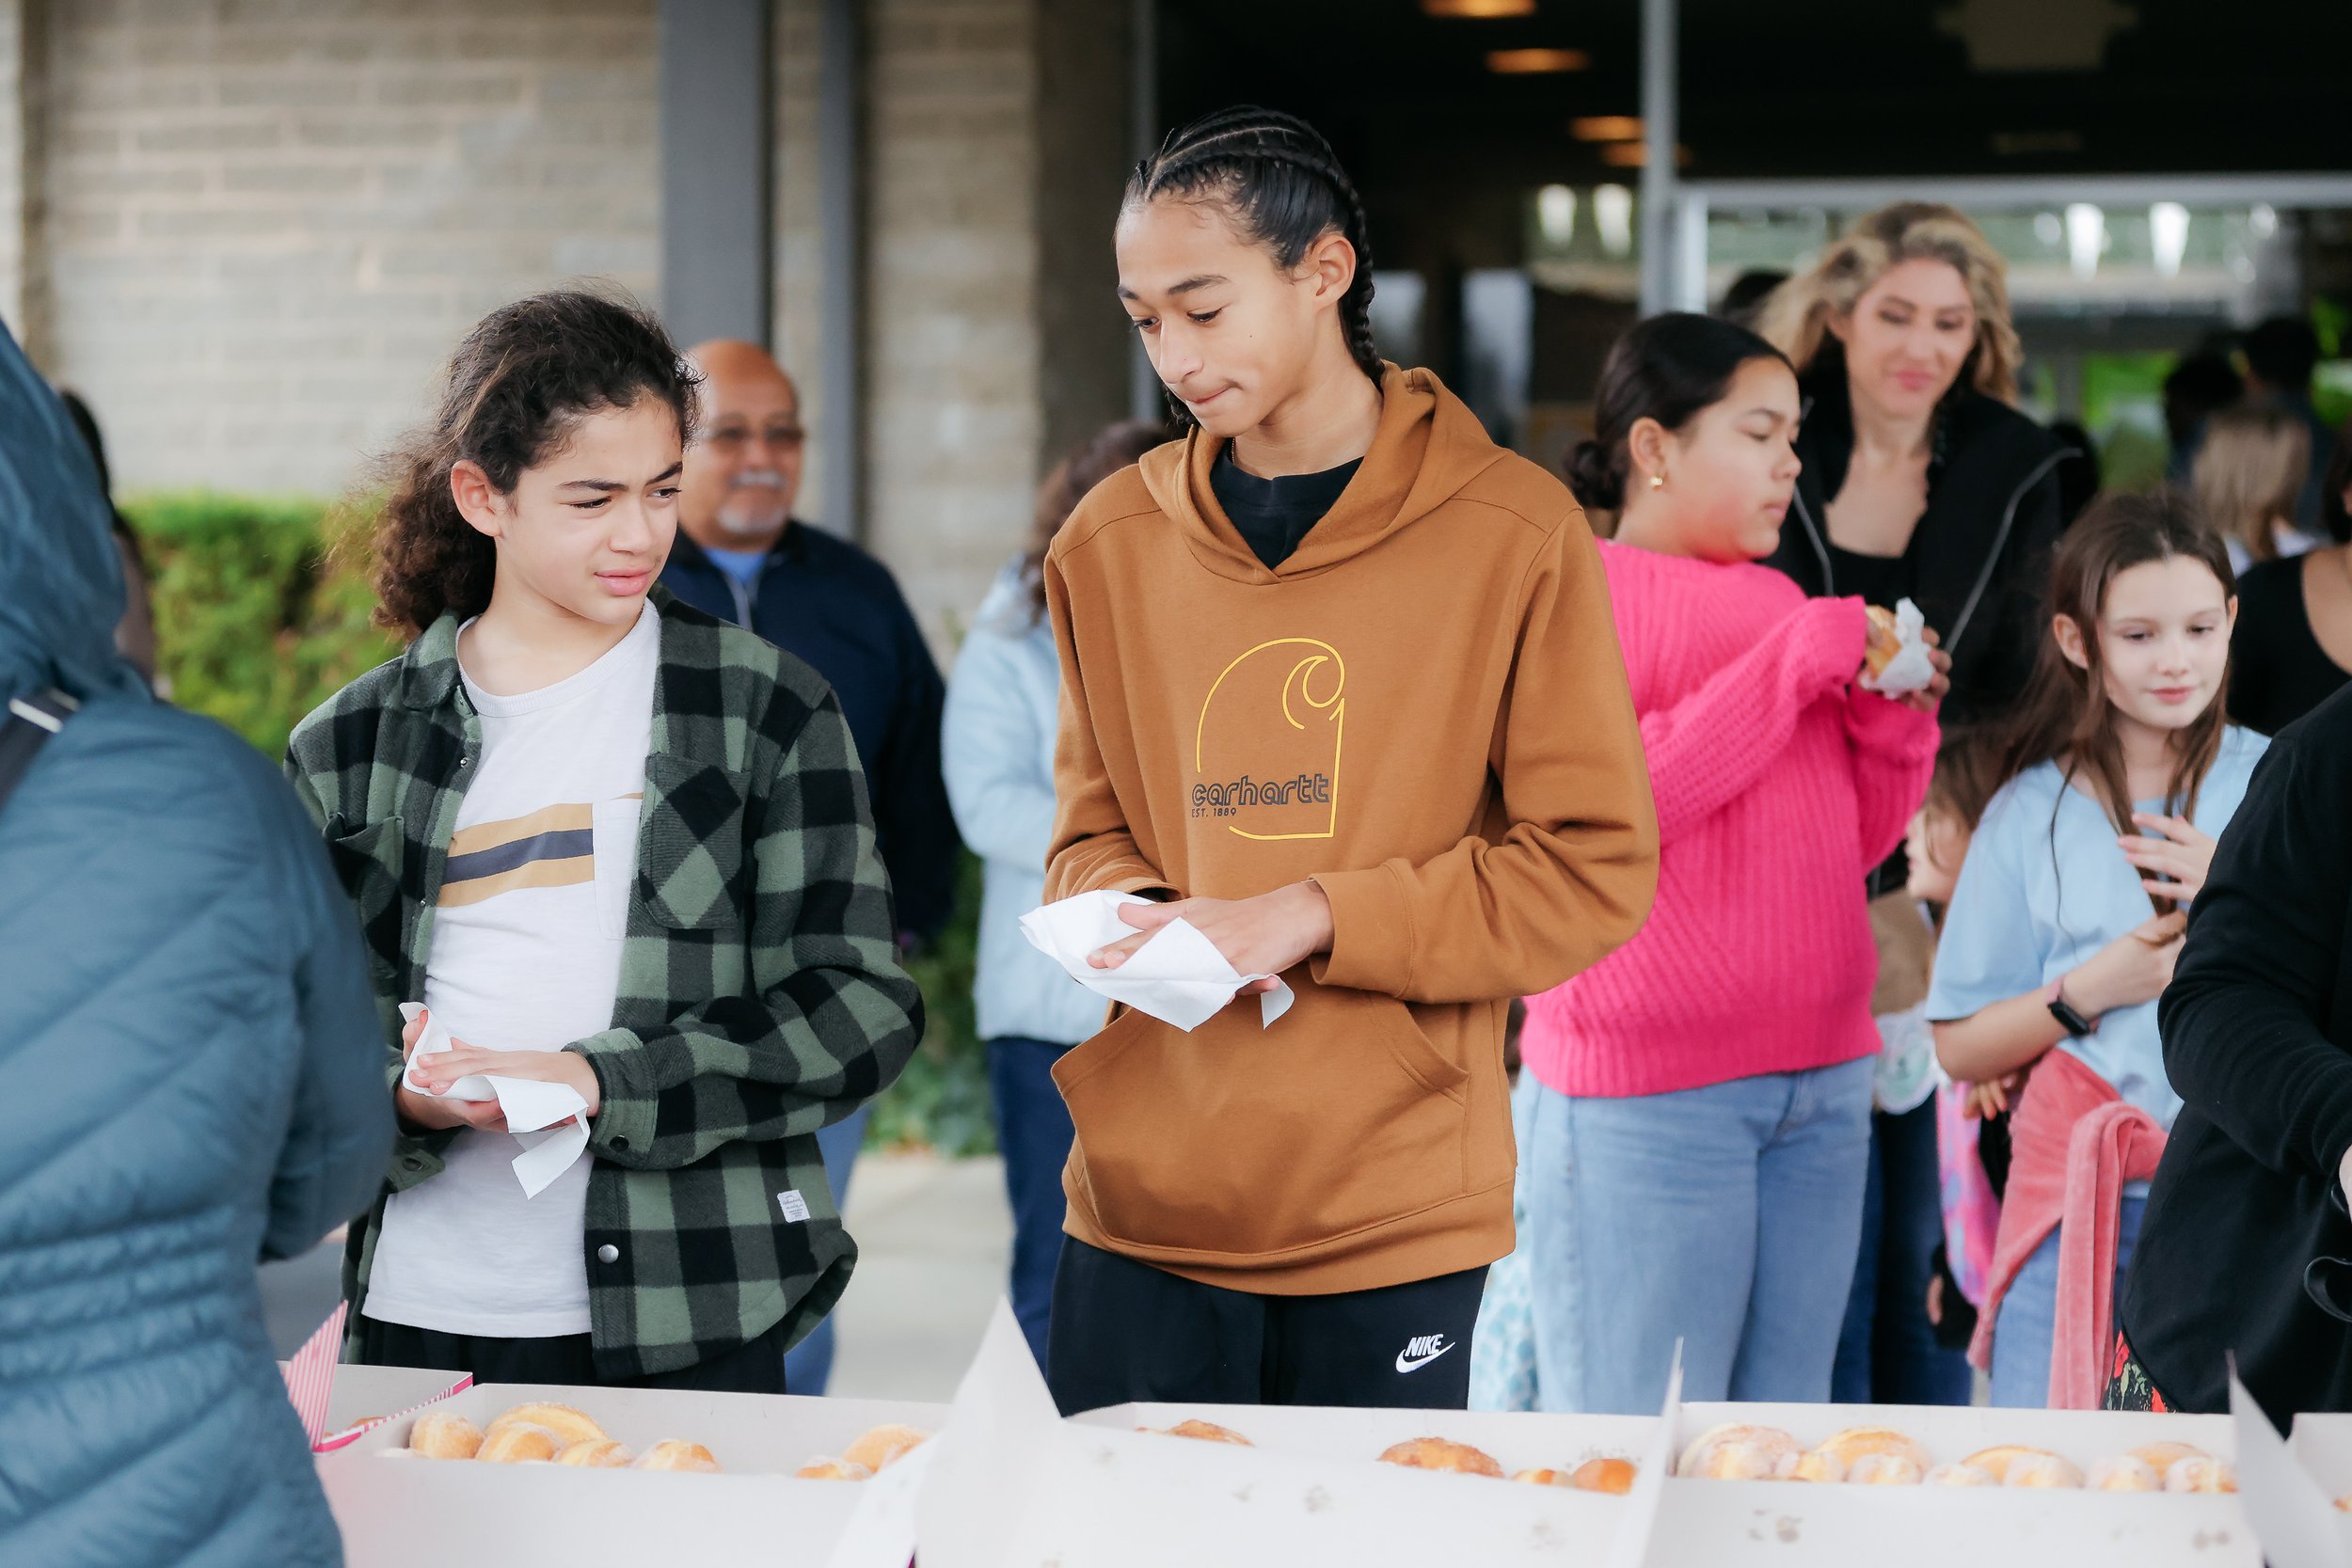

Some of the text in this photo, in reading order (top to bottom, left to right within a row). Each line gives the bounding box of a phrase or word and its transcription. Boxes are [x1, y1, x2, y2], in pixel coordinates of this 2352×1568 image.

[1191, 773, 1329, 807] carhartt
[1191, 807, 1237, 817] EST. 1889
[1405, 1333, 1444, 1356] NIKE
